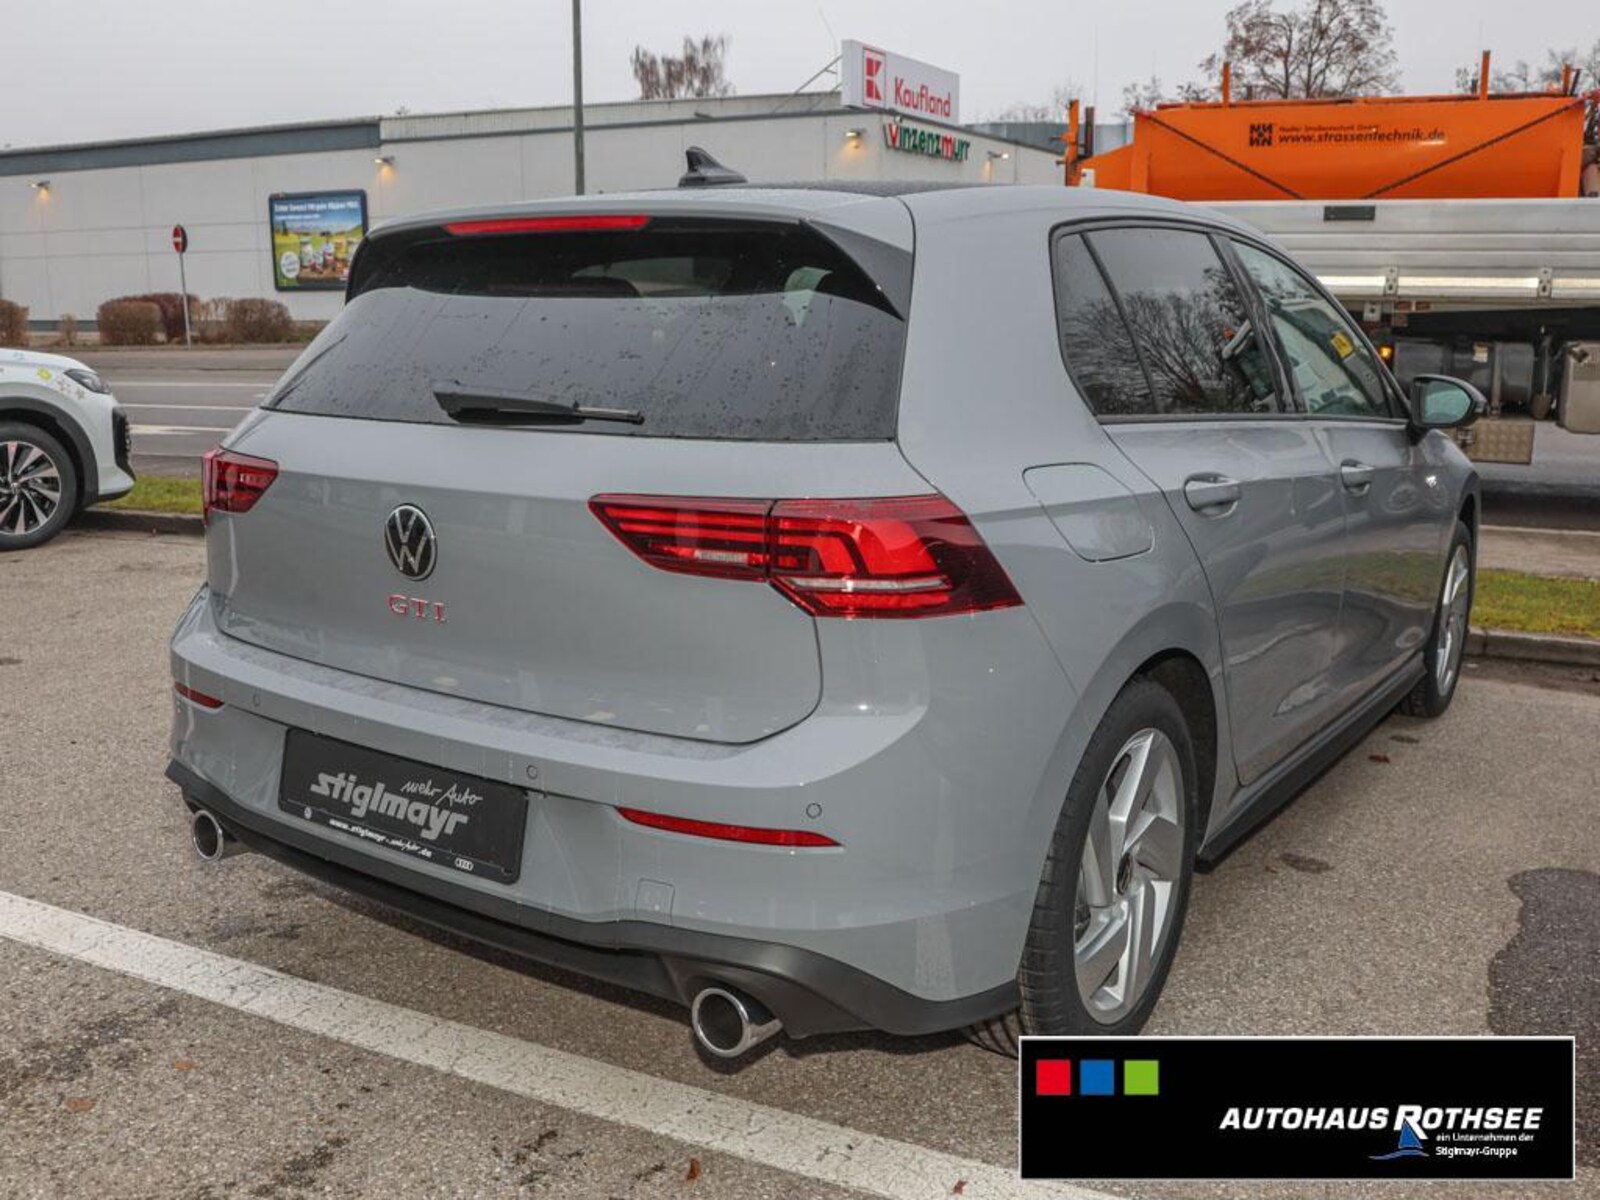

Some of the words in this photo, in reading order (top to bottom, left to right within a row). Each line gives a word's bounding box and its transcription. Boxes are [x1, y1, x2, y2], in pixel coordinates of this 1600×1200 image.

[865, 56, 883, 101] K
[894, 77, 951, 118] Kaufland
[1278, 128, 1445, 144] www.strassentechnik.de
[386, 594, 446, 623] GTI
[310, 772, 469, 840] stiglmayr
